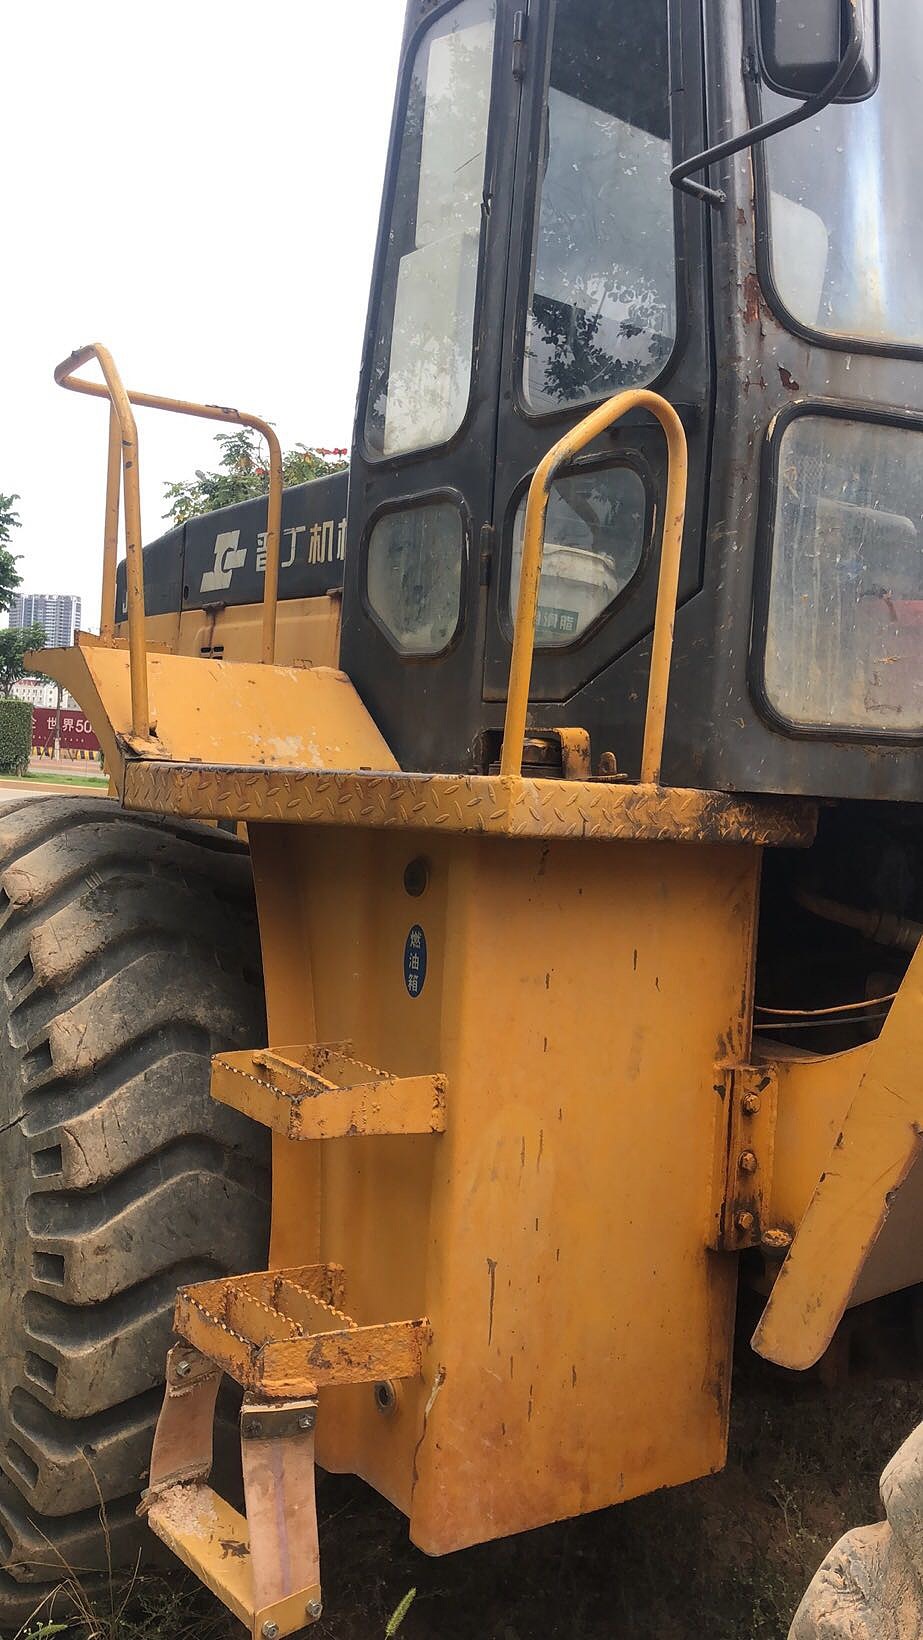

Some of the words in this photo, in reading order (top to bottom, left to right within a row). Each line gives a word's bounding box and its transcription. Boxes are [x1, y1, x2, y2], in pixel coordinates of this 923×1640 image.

[46, 716, 95, 734] 世界50
[408, 930, 421, 993] 燃油箱
